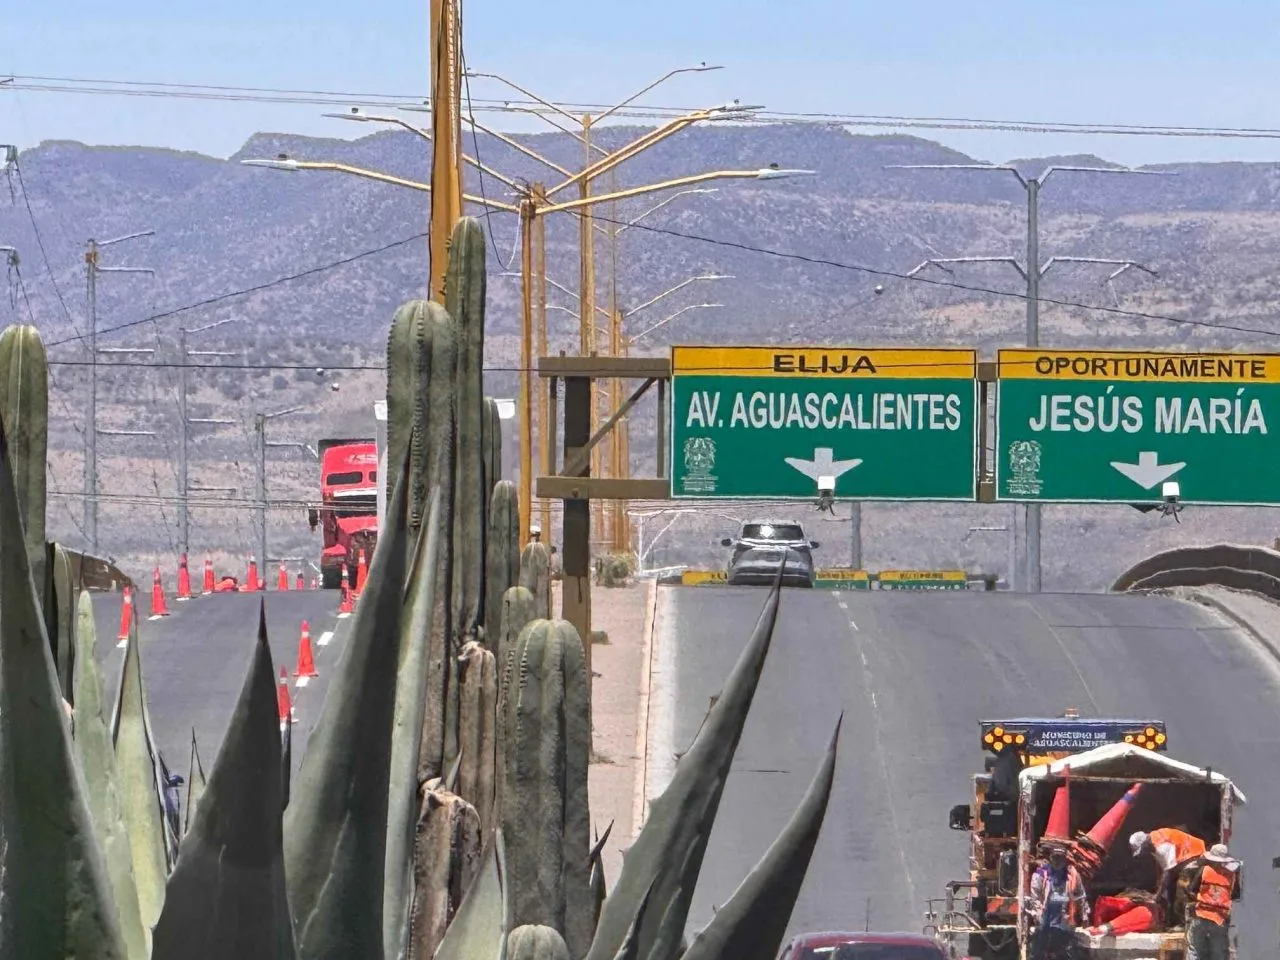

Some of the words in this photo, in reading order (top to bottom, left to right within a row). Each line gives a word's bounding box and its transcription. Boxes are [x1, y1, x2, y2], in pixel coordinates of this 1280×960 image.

[773, 355, 877, 374] ELIJA
[1035, 357, 1267, 378] OPORTUNAMENTE
[686, 391, 724, 429] AV.
[730, 392, 961, 431] AGUASCALIENTES
[1028, 385, 1143, 434] JESÚS
[1155, 387, 1268, 435] MARÍA
